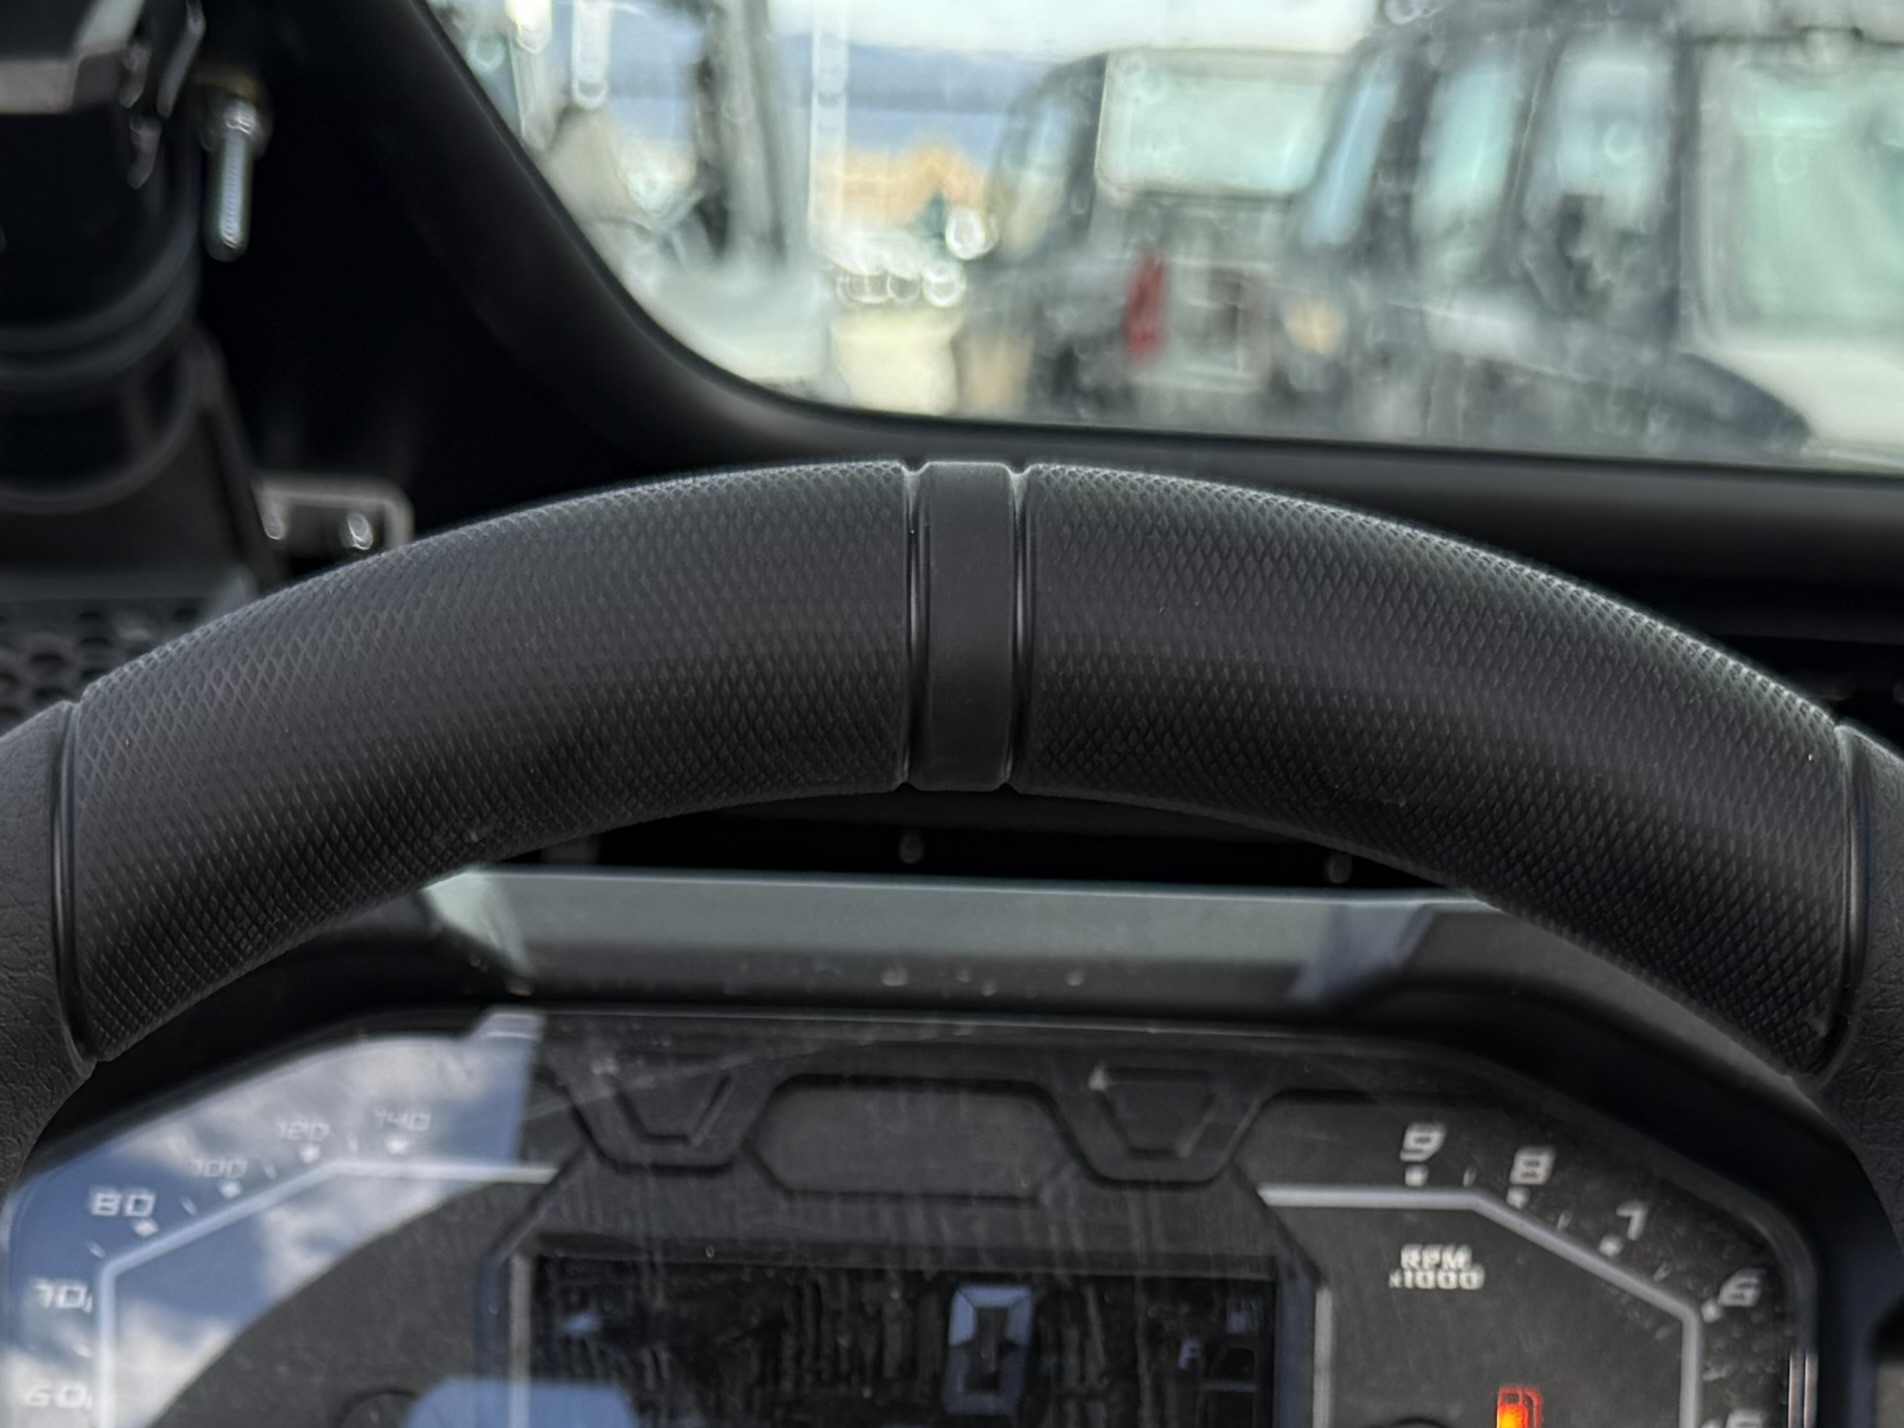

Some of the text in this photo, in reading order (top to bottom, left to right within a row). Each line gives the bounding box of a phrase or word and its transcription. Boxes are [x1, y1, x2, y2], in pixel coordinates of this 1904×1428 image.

[1400, 1123, 1446, 1161] 9
[1509, 1146, 1555, 1184] 8
[89, 1188, 156, 1220] 80
[1617, 1204, 1648, 1240] 7
[1400, 1243, 1473, 1270] RPM
[34, 1280, 89, 1311] 70
[1719, 1268, 1764, 1306] 6
[25, 1380, 86, 1410] 60
